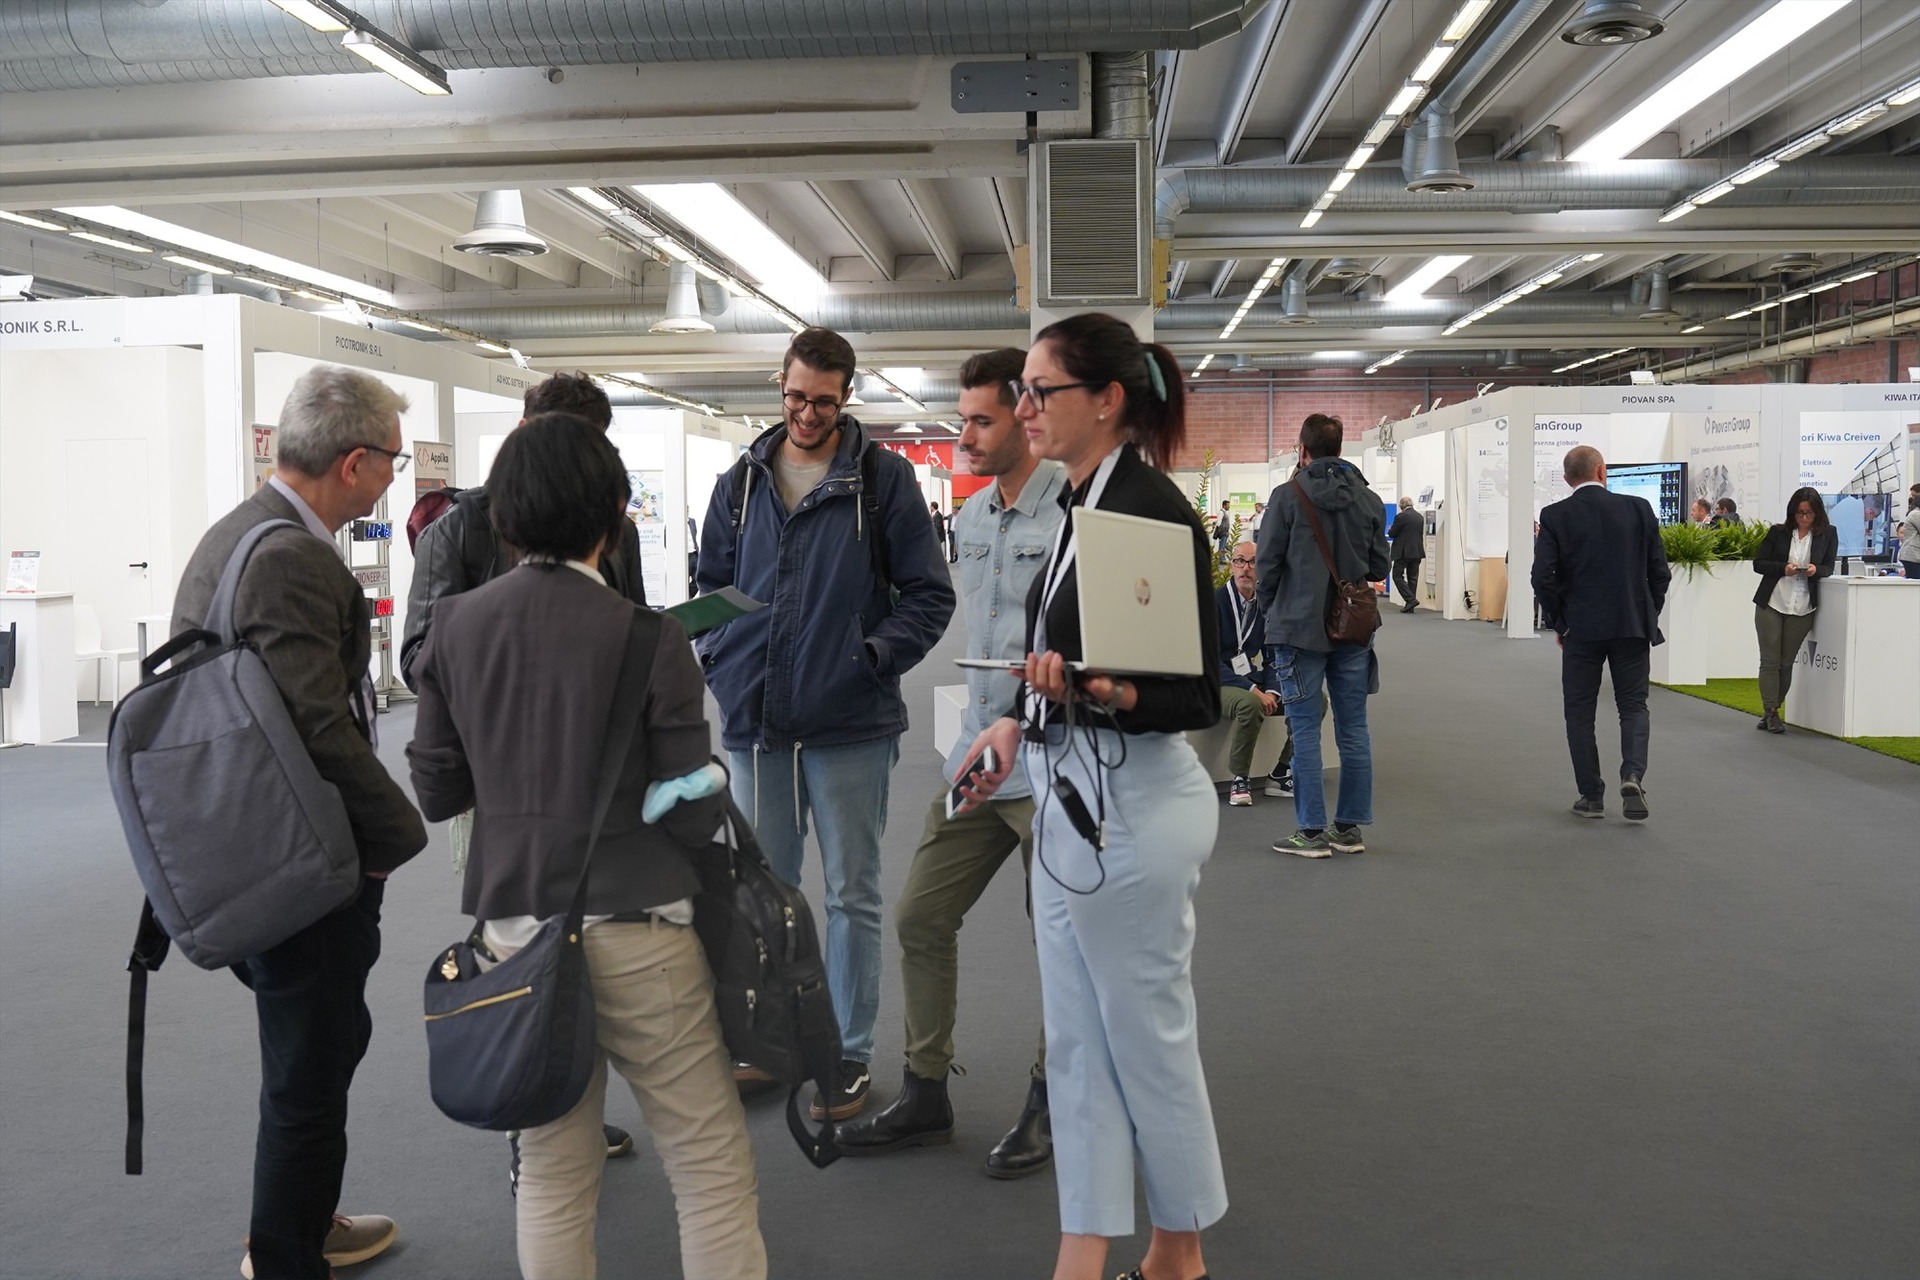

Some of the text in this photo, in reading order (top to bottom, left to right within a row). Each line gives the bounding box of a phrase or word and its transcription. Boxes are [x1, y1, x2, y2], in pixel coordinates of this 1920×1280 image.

[43, 320, 84, 333] S.R.L.
[335, 335, 368, 354] PICOTRONIK
[1621, 395, 1676, 404] PIOVAN SPA
[1884, 393, 1908, 402] KIWA
[1817, 433, 1841, 442] Kiwa
[1843, 432, 1881, 441] Creiven
